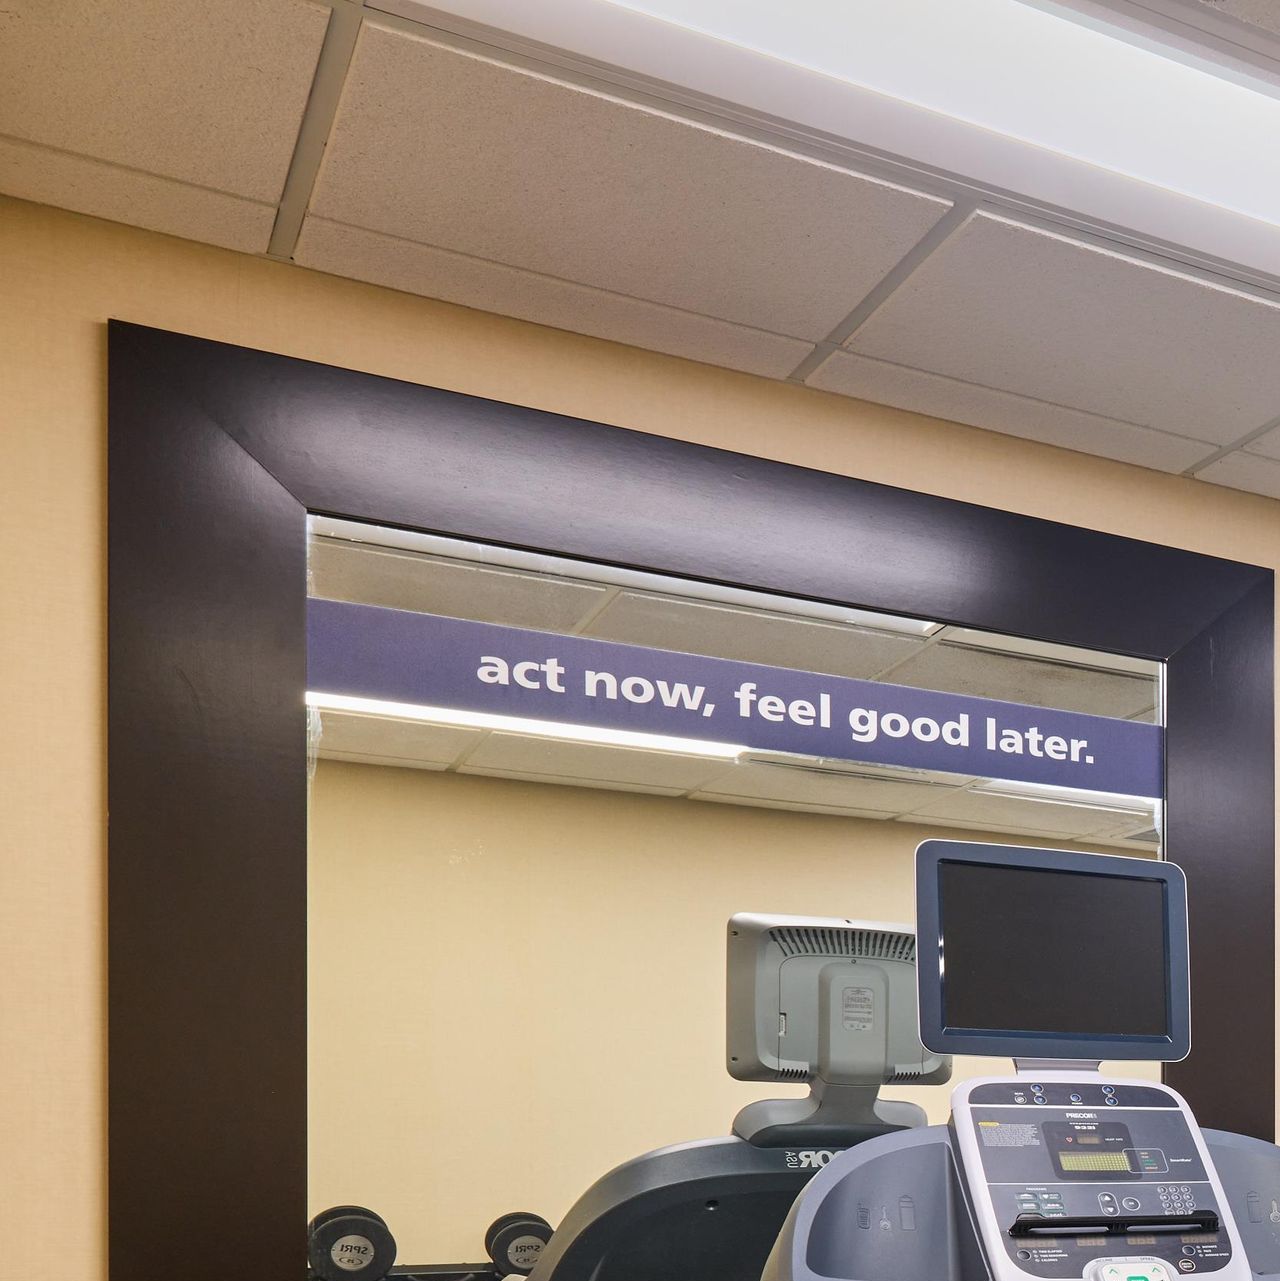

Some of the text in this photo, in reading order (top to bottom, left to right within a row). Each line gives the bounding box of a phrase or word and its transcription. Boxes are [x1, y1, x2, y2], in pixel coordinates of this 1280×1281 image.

[477, 656, 1094, 764] act now, feel good later.
